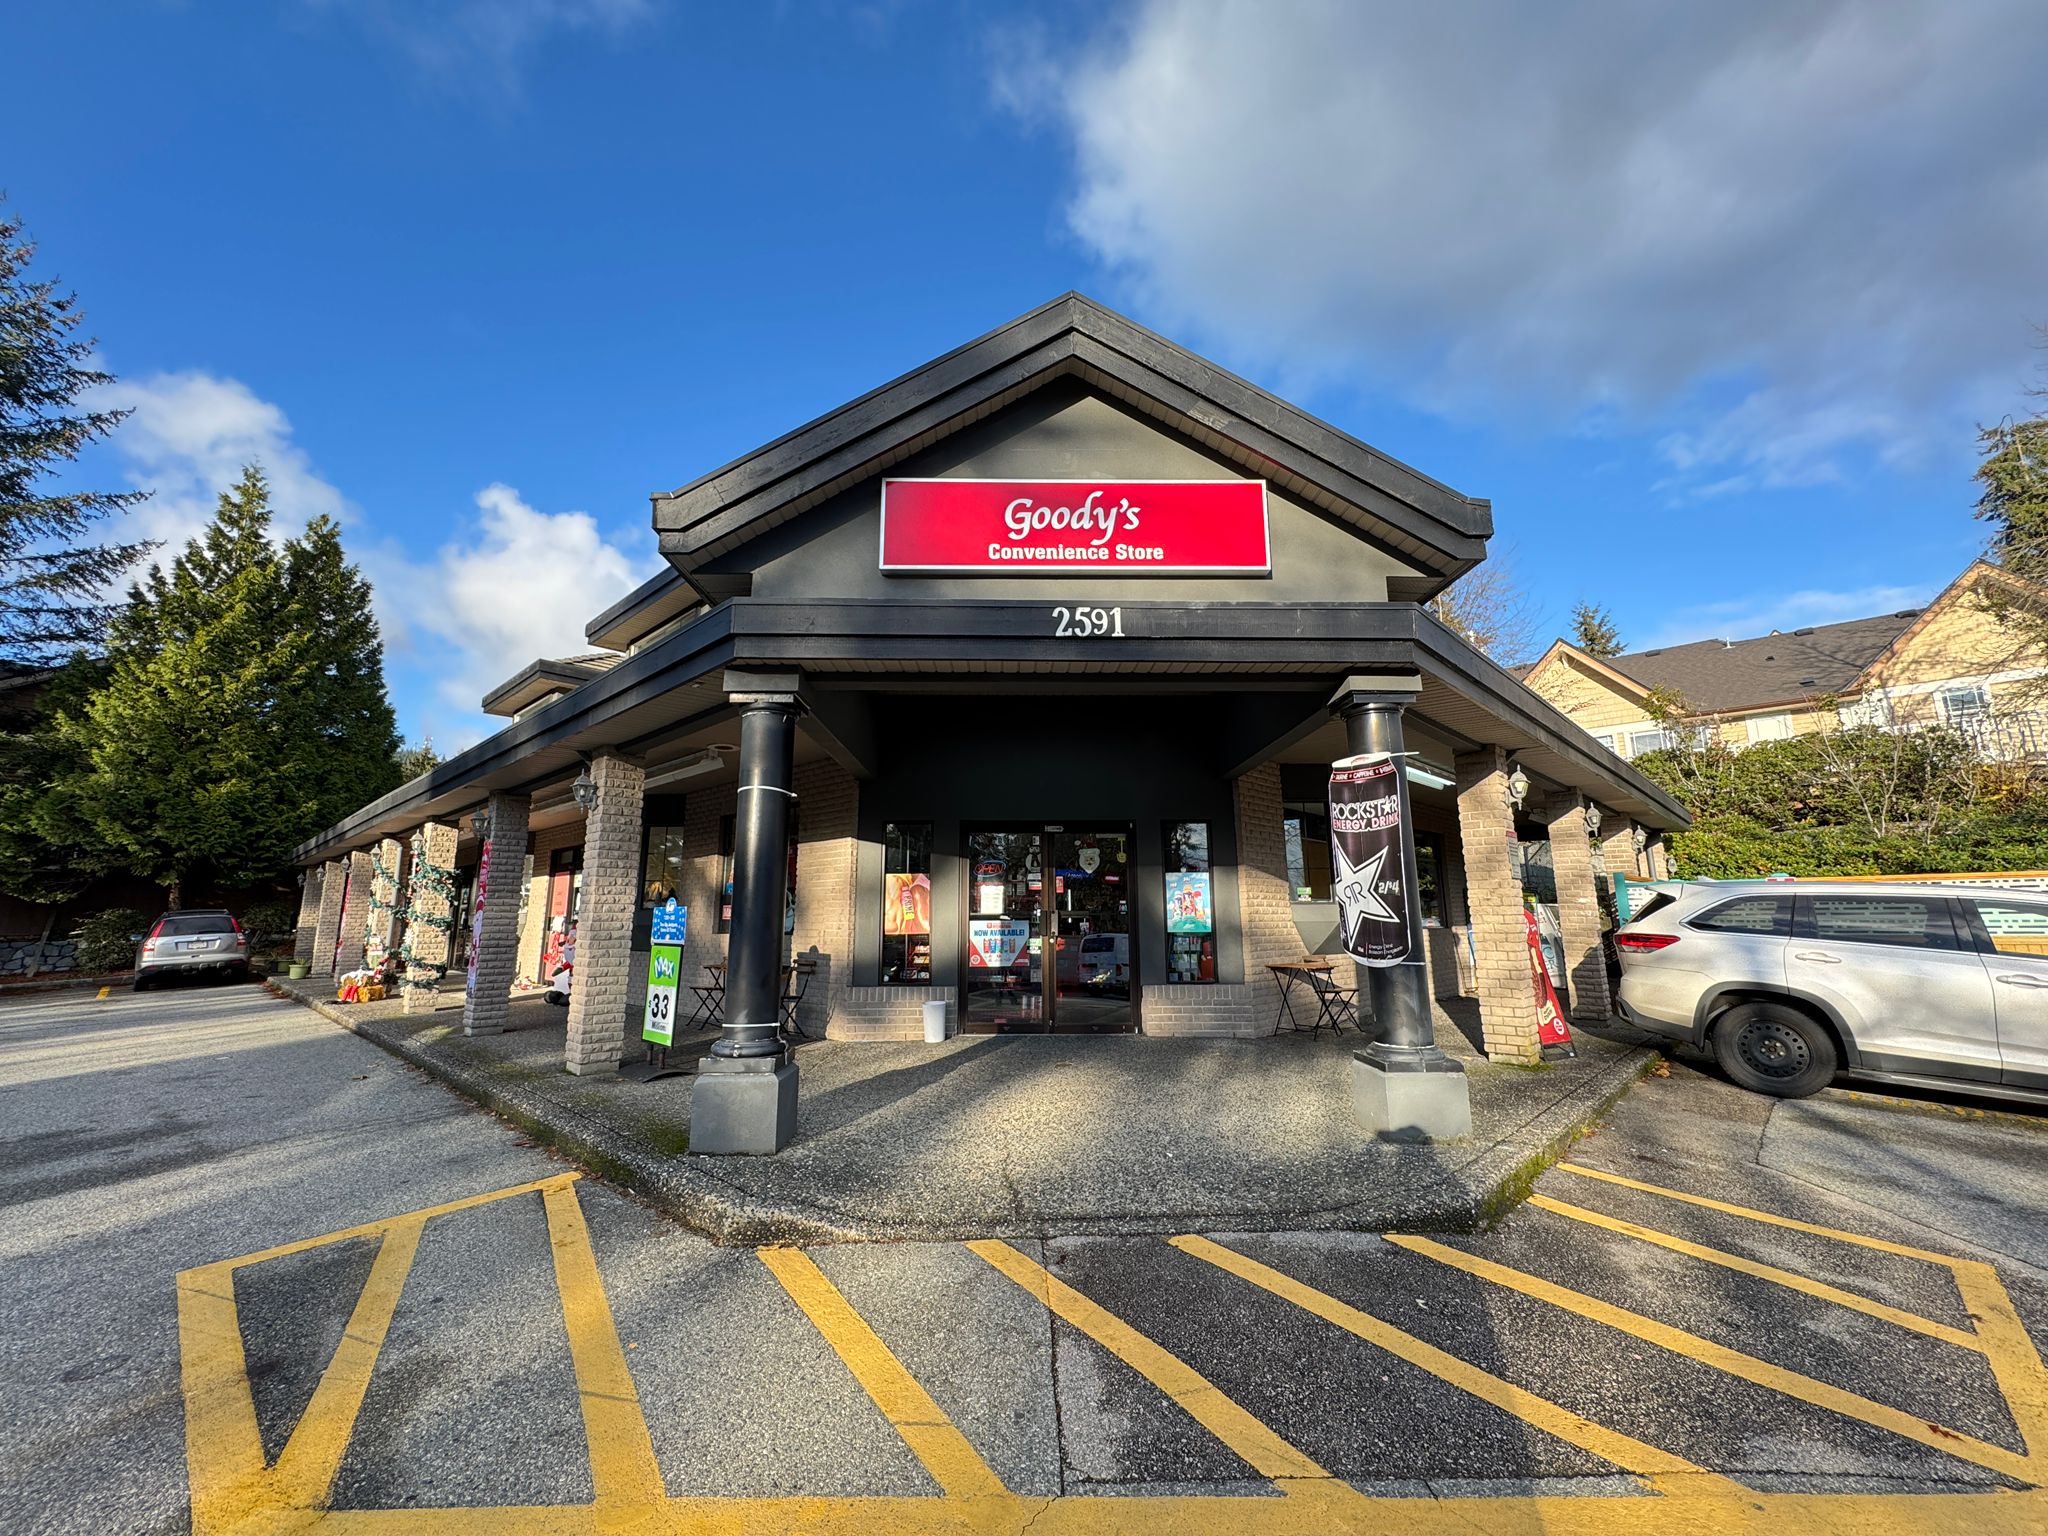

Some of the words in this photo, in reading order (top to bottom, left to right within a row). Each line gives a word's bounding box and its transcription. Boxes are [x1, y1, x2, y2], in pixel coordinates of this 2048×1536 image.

[1004, 490, 1142, 546] Goody's
[988, 543, 1109, 560] Convenience
[1115, 543, 1164, 560] Store
[1051, 606, 1126, 638] 2591
[1332, 818, 1367, 831] ENERGY
[1371, 812, 1398, 828] DRINK
[974, 863, 1004, 874] OPEN
[973, 929, 989, 937] NOW
[989, 928, 1025, 937] AVAILABLE!
[653, 955, 675, 980] MAX
